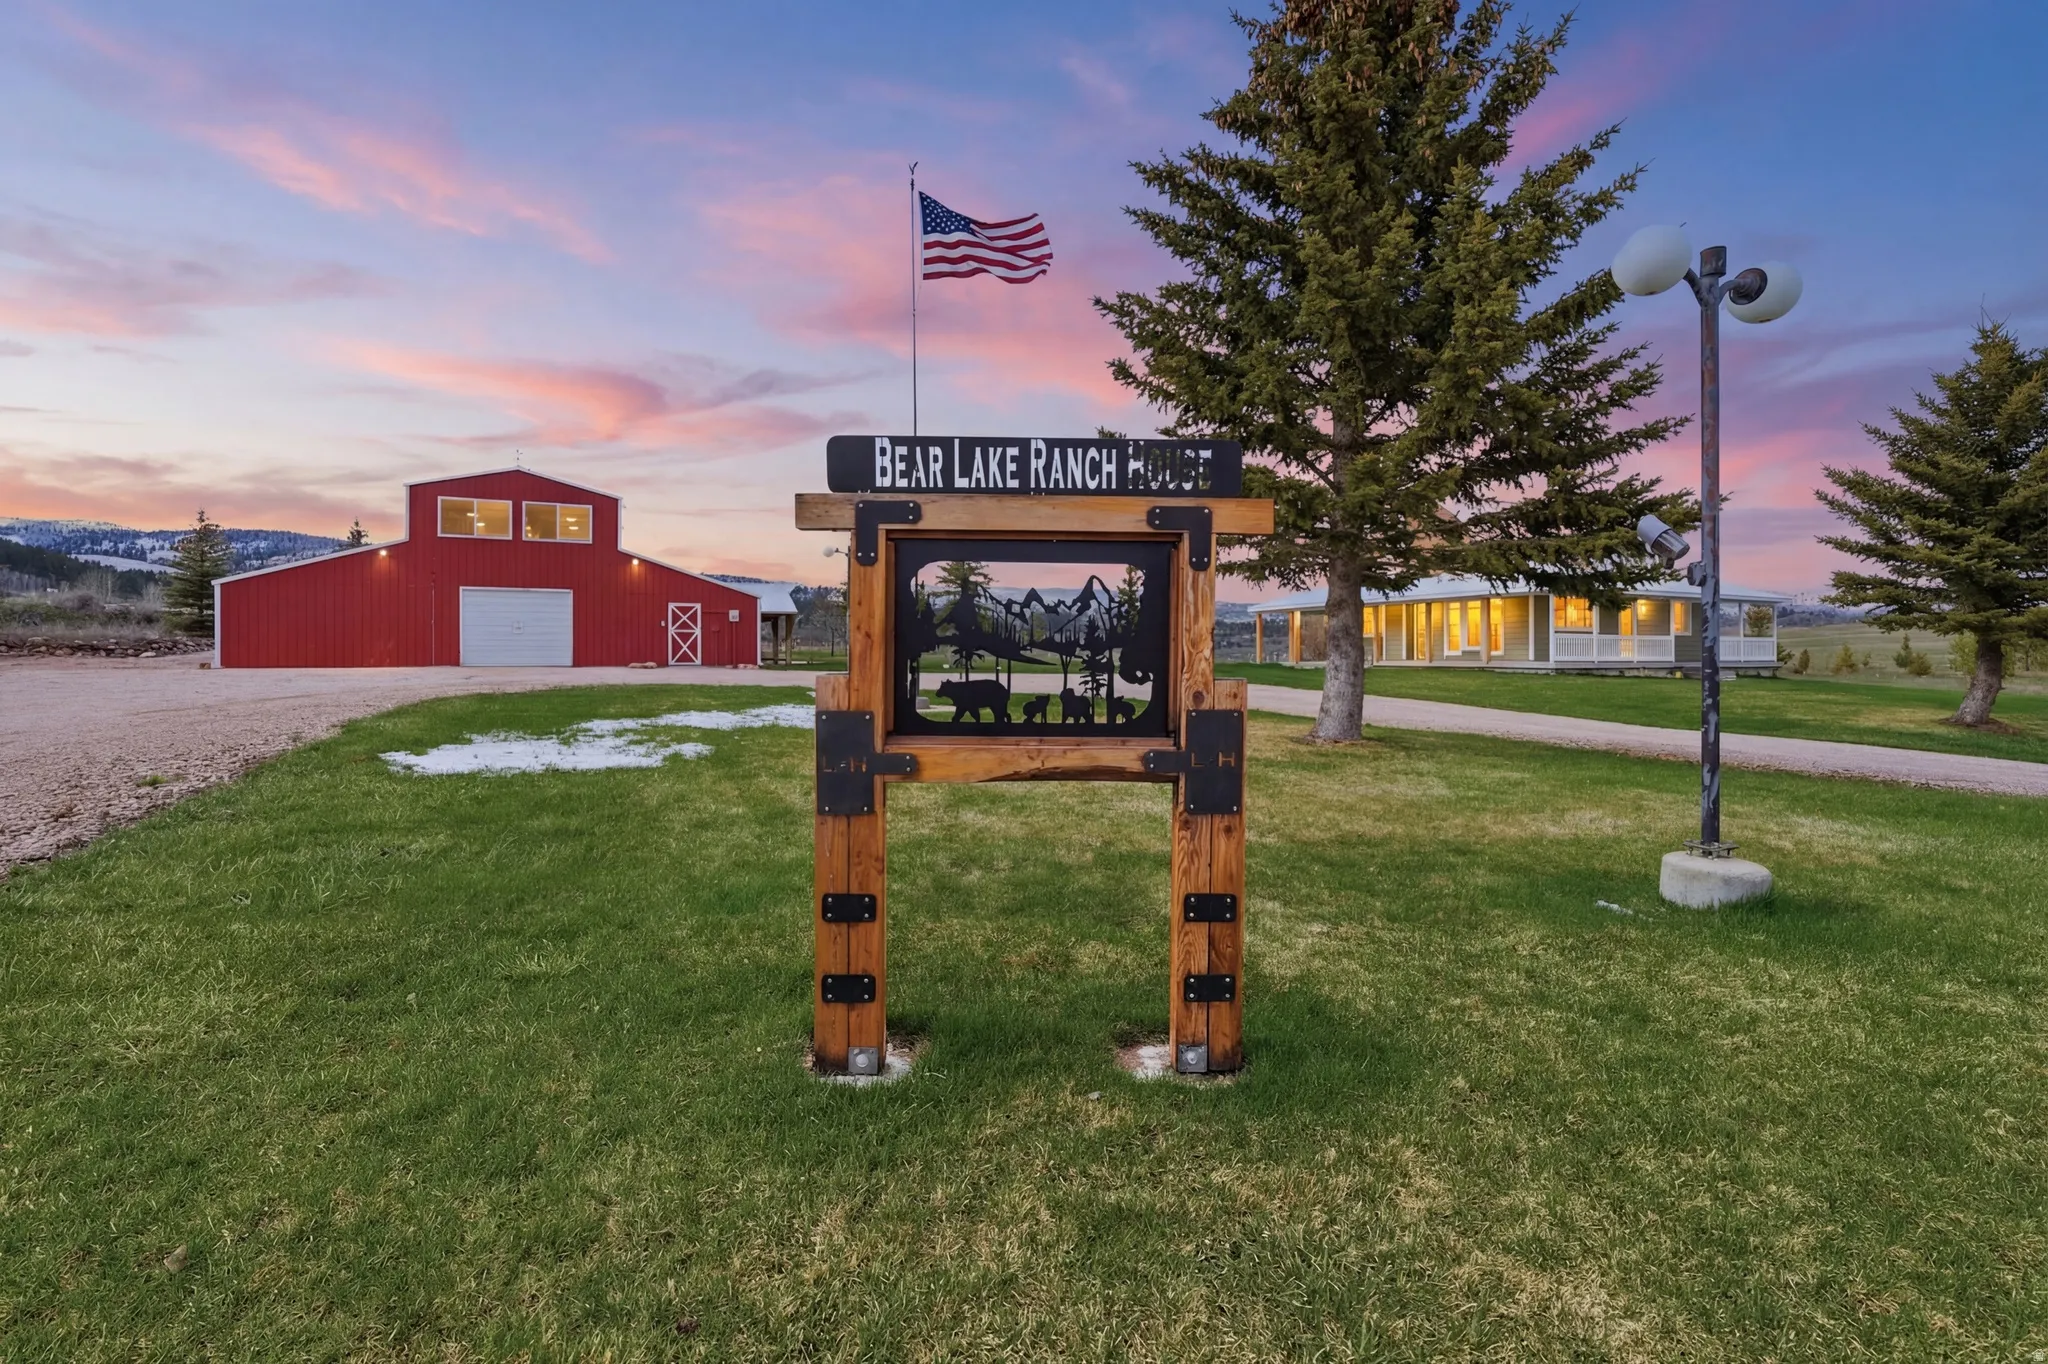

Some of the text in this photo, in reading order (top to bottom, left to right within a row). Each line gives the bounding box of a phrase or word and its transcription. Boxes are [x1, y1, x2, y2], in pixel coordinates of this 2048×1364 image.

[875, 437, 1212, 490] BEAR LAKE RANCH HOUSE
